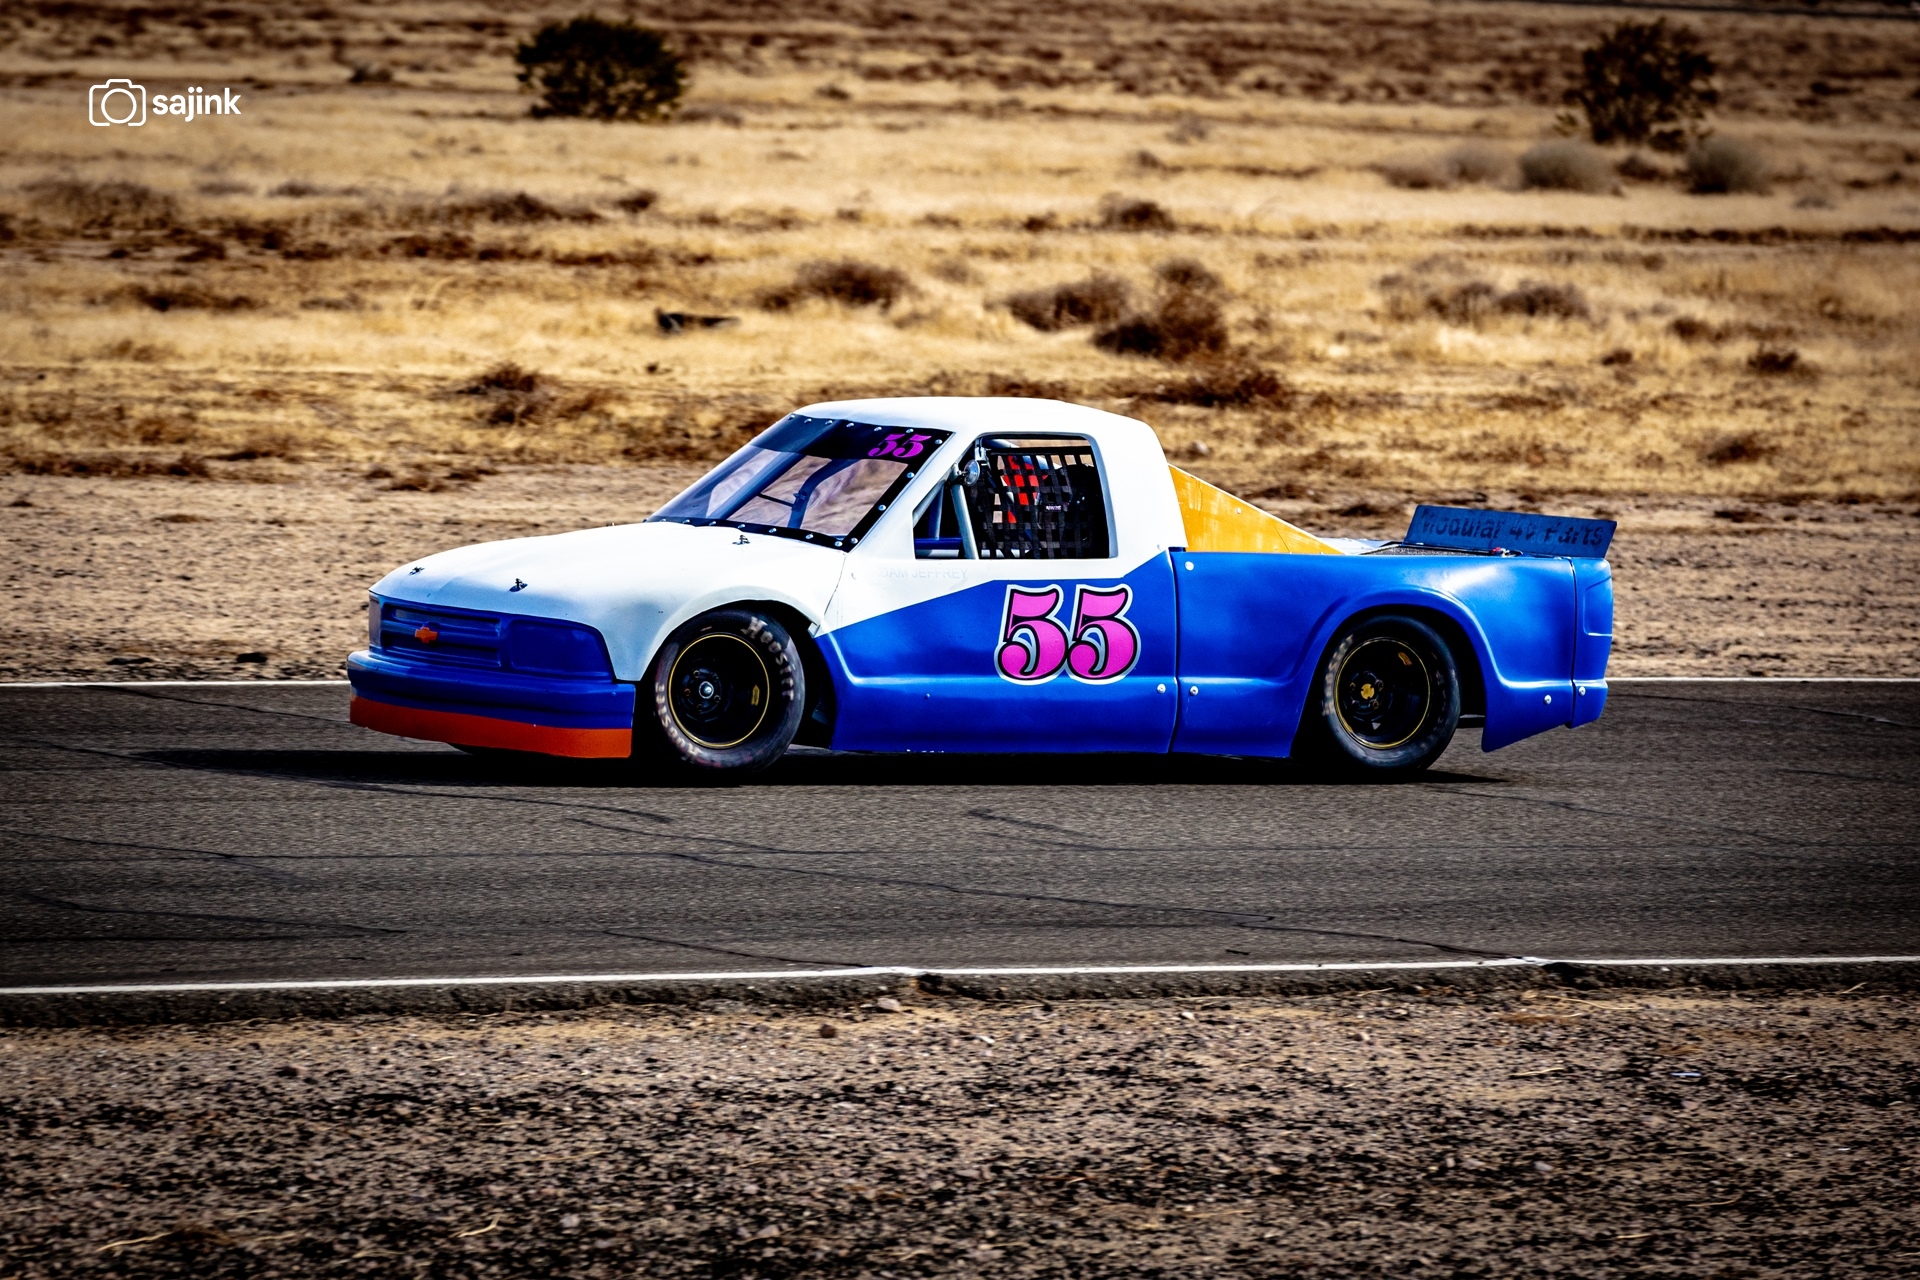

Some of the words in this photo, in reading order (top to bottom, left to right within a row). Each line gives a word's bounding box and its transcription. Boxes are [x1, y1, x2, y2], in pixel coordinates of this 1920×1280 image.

[868, 433, 932, 458] 55
[911, 567, 968, 580] JEFFREY
[993, 583, 1142, 686] 55
